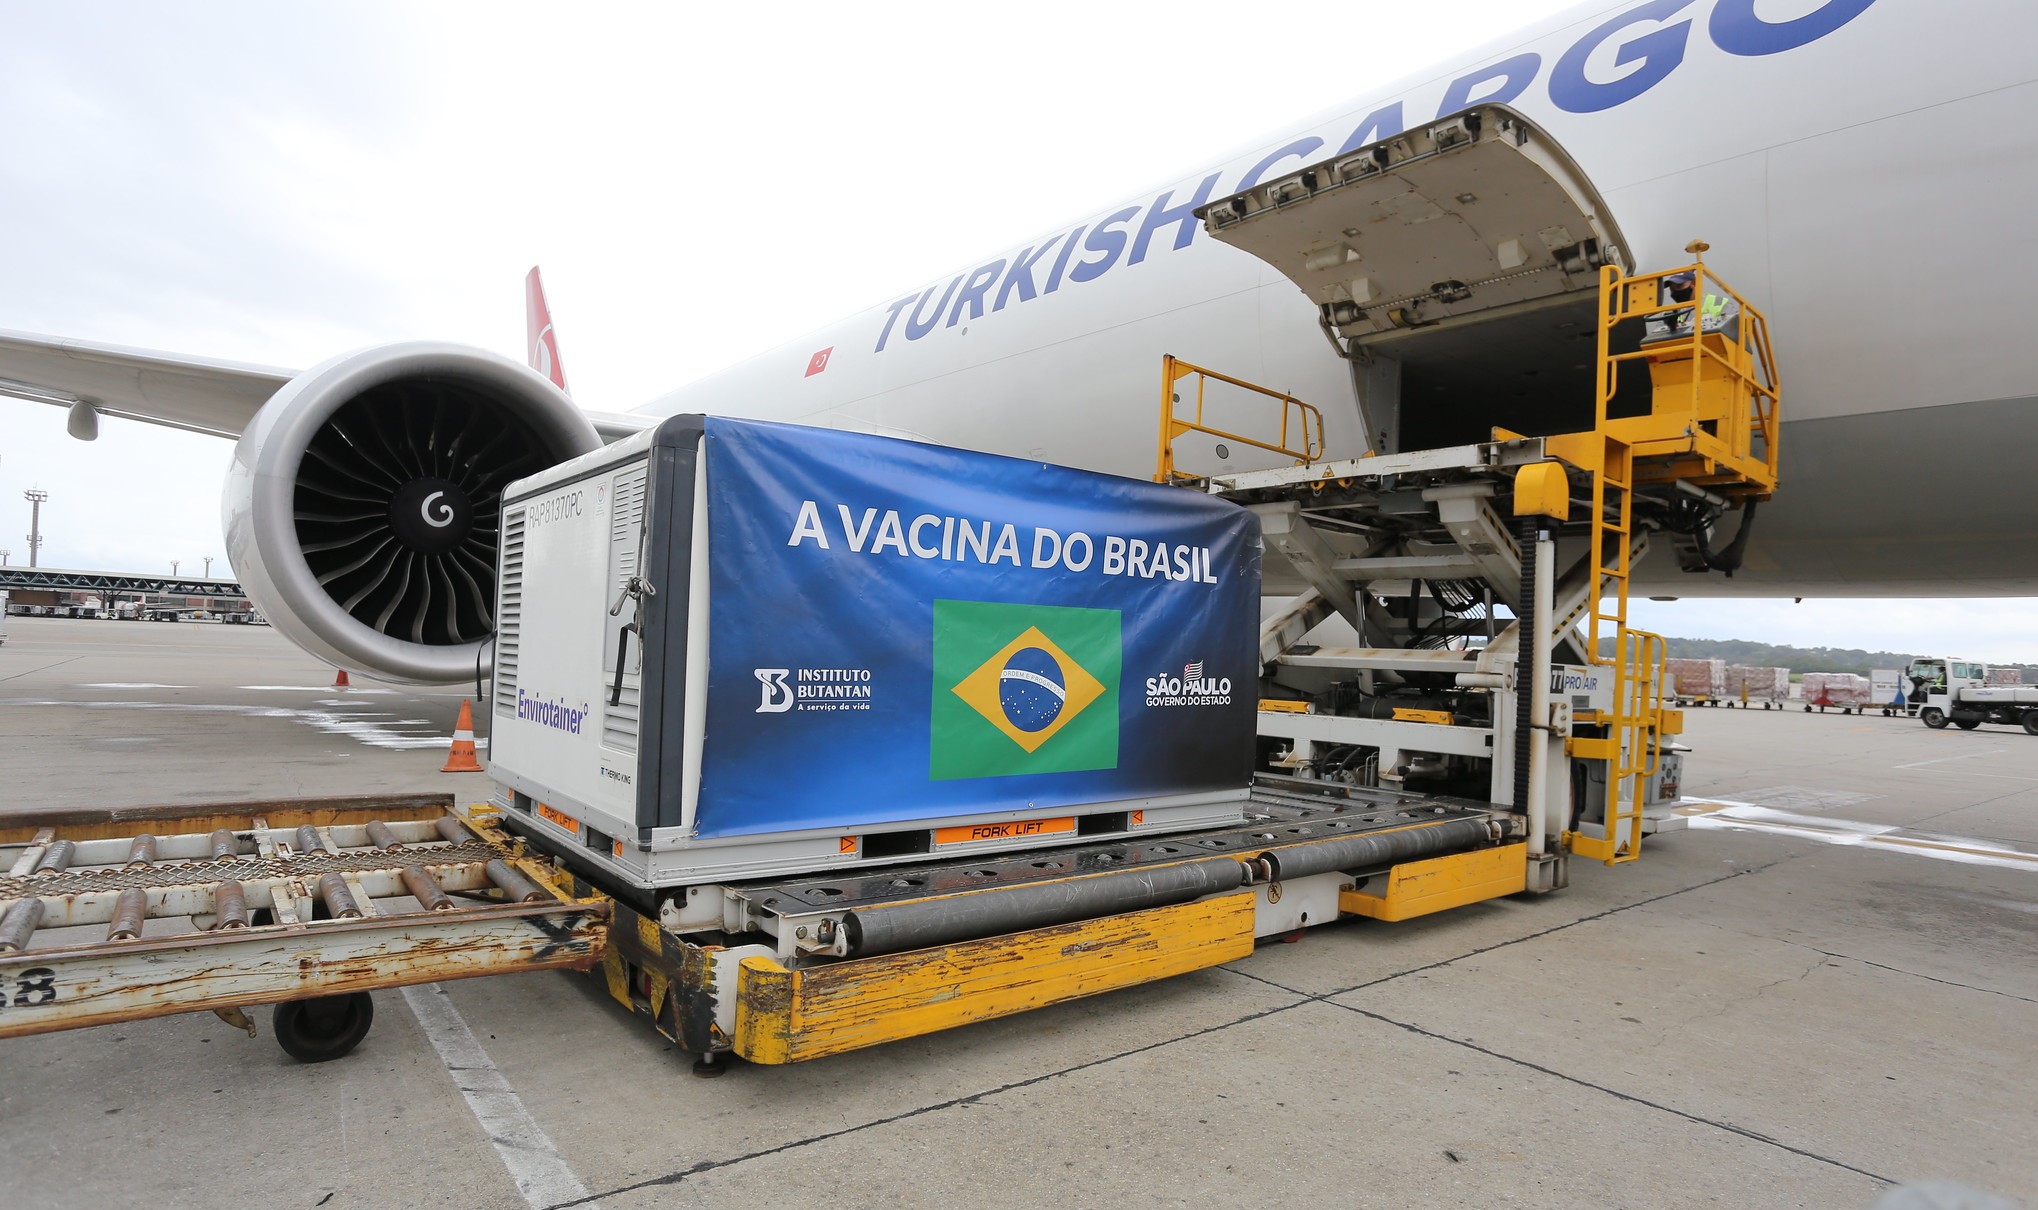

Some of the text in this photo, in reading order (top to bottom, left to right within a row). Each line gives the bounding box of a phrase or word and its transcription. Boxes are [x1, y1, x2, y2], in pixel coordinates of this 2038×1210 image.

[875, 171, 1223, 354] TURKISH
[529, 490, 583, 529] RAP81370PC
[788, 500, 1218, 584] A VACINA DO BRASIL
[797, 668, 871, 682] INSTITUTO
[1003, 670, 1024, 678] ORDEM
[1030, 674, 1064, 697] PROGRESSO
[1146, 672, 1232, 696] SÃO PAULO
[1564, 676, 1582, 690] PRO
[1583, 677, 1598, 691] AIR
[797, 685, 871, 698] BUTANTAN
[1146, 695, 1231, 707] GOVERNO DO ESTADO
[518, 688, 583, 735] Envirotainer
[797, 703, 804, 711] A
[807, 703, 837, 712] serviço
[853, 702, 870, 710] vida
[972, 822, 1044, 839] FORK LIFT
[0, 968, 57, 1007] 8
